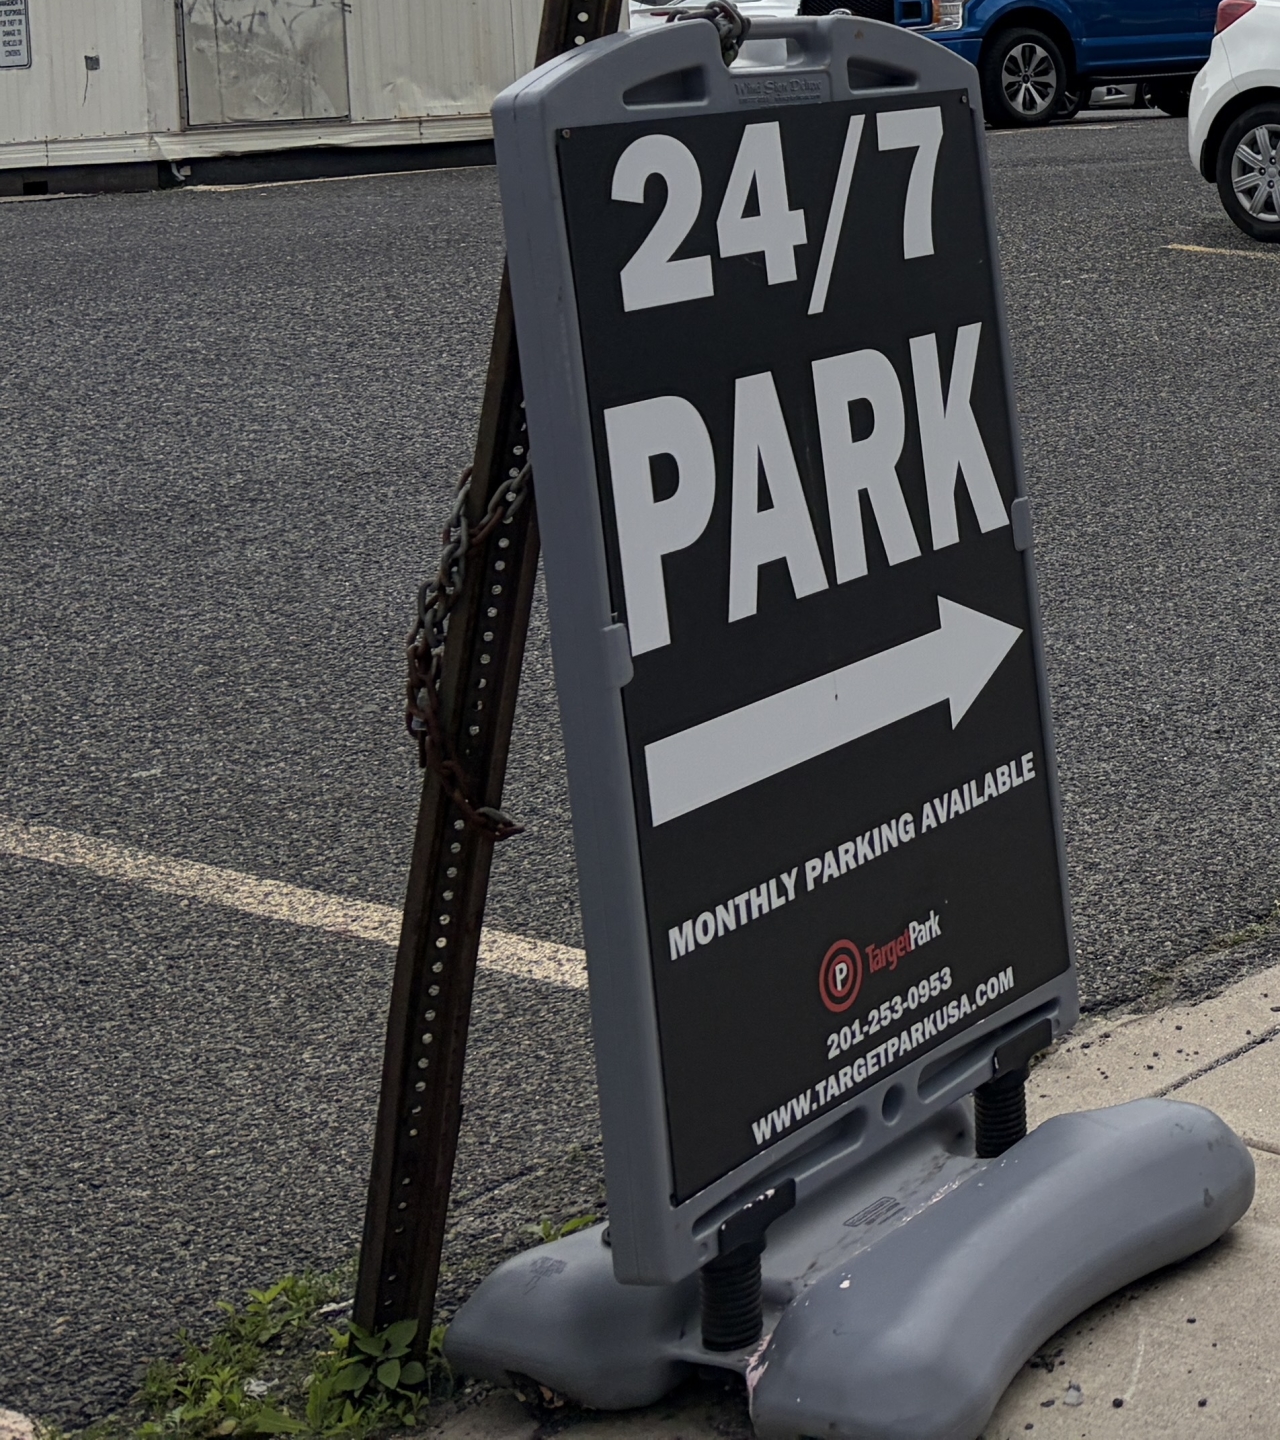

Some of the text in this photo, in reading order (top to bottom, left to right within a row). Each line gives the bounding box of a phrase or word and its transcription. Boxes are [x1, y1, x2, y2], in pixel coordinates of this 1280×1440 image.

[611, 106, 943, 315] 24/7
[604, 321, 1010, 657] PARK
[668, 752, 1036, 961] MONTHLY PARKING AVAILABLE
[835, 910, 942, 990] P TargetPark
[751, 966, 1015, 1145] WWW.TARGETPARKUSA.COM
[827, 967, 952, 1059] 201-253-0953
